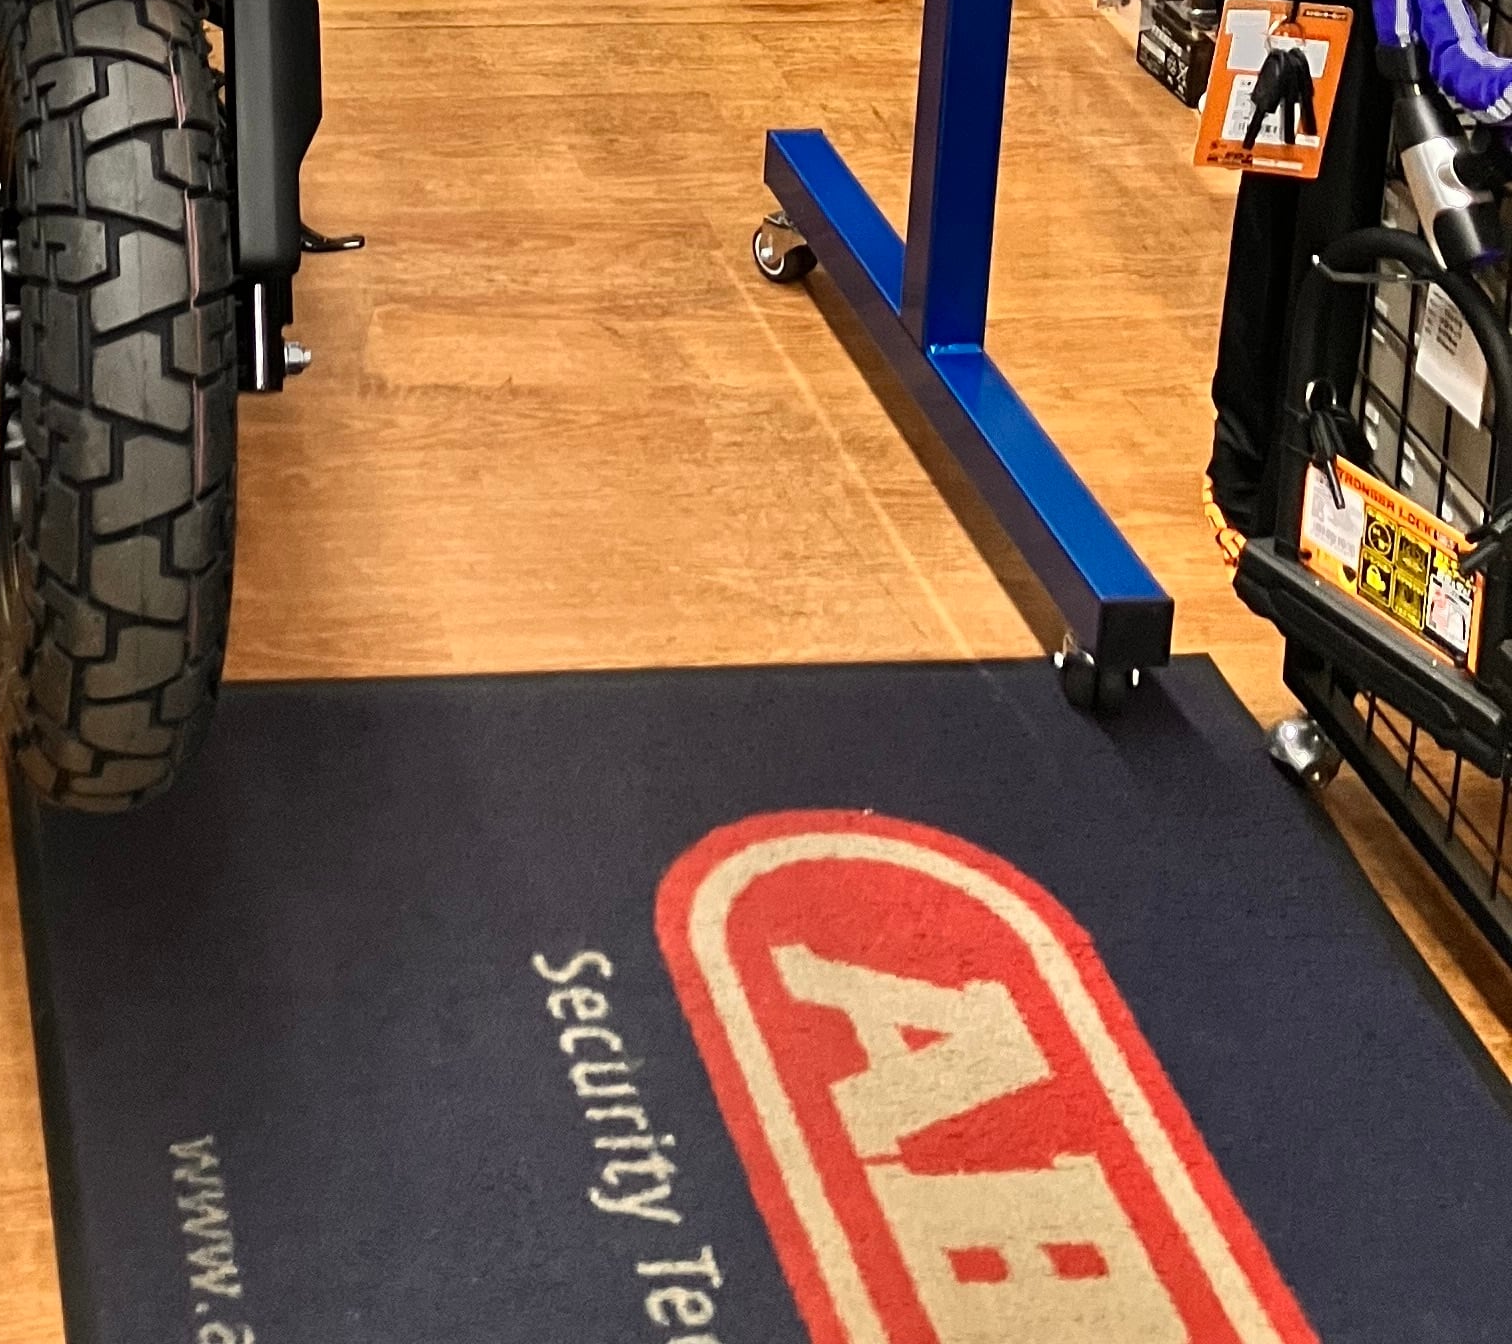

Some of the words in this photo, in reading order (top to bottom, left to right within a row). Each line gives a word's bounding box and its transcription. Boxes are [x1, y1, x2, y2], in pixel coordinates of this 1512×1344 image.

[1337, 468, 1396, 514] TRONGER
[533, 950, 681, 1224] Security
[636, 1246, 726, 1344] Te
